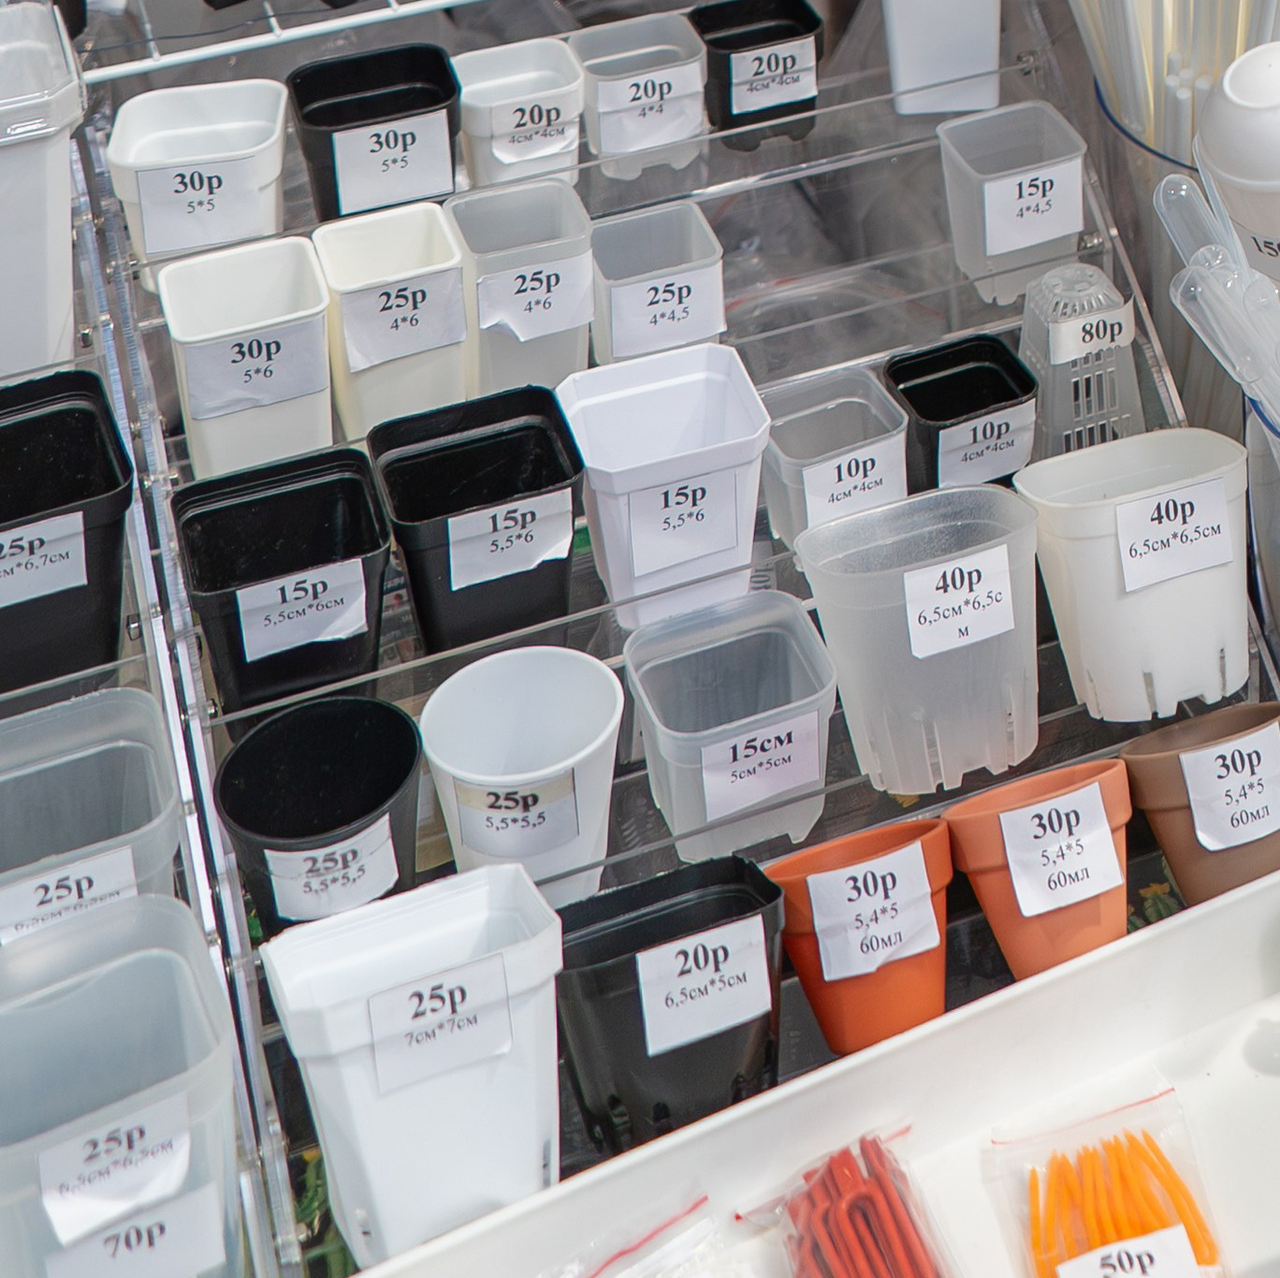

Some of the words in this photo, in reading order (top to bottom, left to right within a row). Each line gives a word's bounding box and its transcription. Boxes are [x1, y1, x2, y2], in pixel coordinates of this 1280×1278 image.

[752, 52, 798, 77] 20р
[629, 78, 672, 103] 20р
[513, 104, 561, 129] 20р
[369, 129, 417, 155] 30р
[173, 170, 223, 196] 30р
[1016, 176, 1055, 200] 15р
[513, 270, 561, 295] 25р
[647, 282, 692, 307] 25р
[378, 287, 427, 313] 25р
[1080, 318, 1123, 344] 80р
[230, 338, 282, 364] 30р
[969, 421, 1011, 445] 10р
[834, 456, 877, 484] 10р
[660, 484, 707, 510] 15р
[488, 508, 538, 534] 15р
[1149, 498, 1196, 526] 40р
[275, 578, 329, 605] 15р
[934, 565, 984, 596] 40р
[957, 625, 970, 640] м
[728, 731, 795, 765] 15см
[1213, 747, 1262, 780] 30р
[486, 790, 540, 814] 25р
[1030, 806, 1081, 840] 30р
[1229, 804, 1271, 830] 60мл
[302, 847, 360, 878] 25р
[33, 874, 95, 909] 25р
[844, 869, 898, 903] 30р
[1046, 866, 1090, 892] 60мл
[859, 930, 904, 956] 60мл
[674, 942, 730, 977] 20р
[410, 982, 468, 1019] 25р
[81, 1125, 147, 1163] 25р
[102, 1219, 168, 1260] 70р
[1099, 1248, 1156, 1277] 50р
